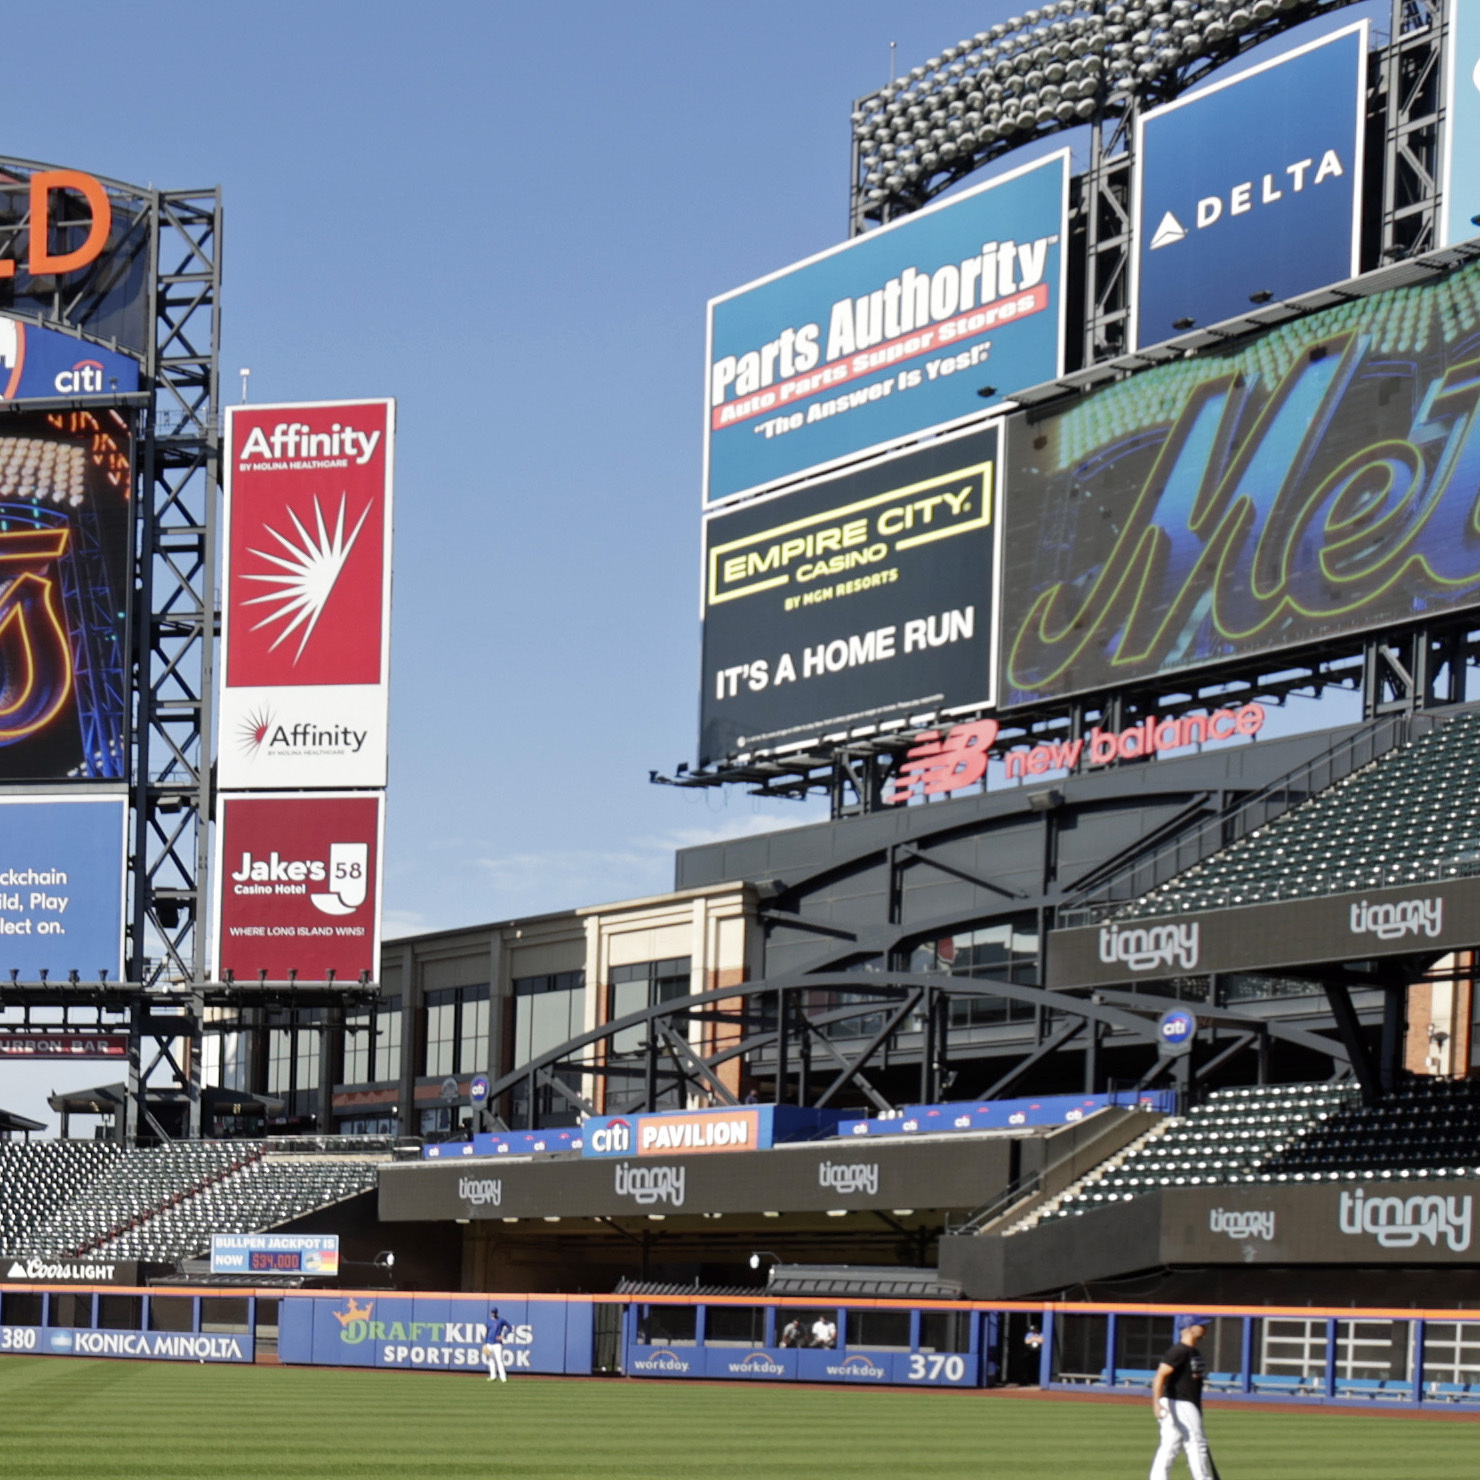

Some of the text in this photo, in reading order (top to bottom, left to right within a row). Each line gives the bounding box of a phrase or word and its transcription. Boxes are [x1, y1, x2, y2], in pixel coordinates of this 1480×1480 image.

[1197, 149, 1344, 229] DELTA
[712, 322, 821, 407] Parts
[720, 294, 1036, 425] Auto Parts Super Stores
[54, 362, 103, 393] citi
[807, 378, 896, 424] Answer
[897, 367, 923, 391] Is
[239, 422, 382, 465] Affinity
[239, 459, 349, 472] BY MOLINA HEALTHCARE
[723, 486, 973, 584] EMPIRE CITY
[795, 542, 888, 582] CASINO
[784, 567, 899, 611] BY MGM RESORTS
[715, 605, 975, 700] IT'S A HOME RUN
[269, 723, 368, 752] Affinity
[1005, 737, 1085, 780] new
[1089, 702, 1266, 765] balance
[231, 851, 363, 882] Jake's 58
[29, 893, 70, 914] Play
[233, 884, 307, 895] Casino Hotel
[36, 920, 66, 936] on.
[229, 926, 366, 937] WHERE LONG ISLAND WINS!
[71, 1040, 110, 1053] BAR
[591, 1120, 749, 1153] citi PAVILION
[215, 1237, 335, 1249] BULLPEN JACKPOT IS
[26, 1256, 115, 1280] Coors LIGHT
[215, 1254, 244, 1266] NOW
[1, 1328, 36, 1350] 380
[75, 1332, 243, 1359] KONICA MINOLTA
[907, 1353, 966, 1382] 370
